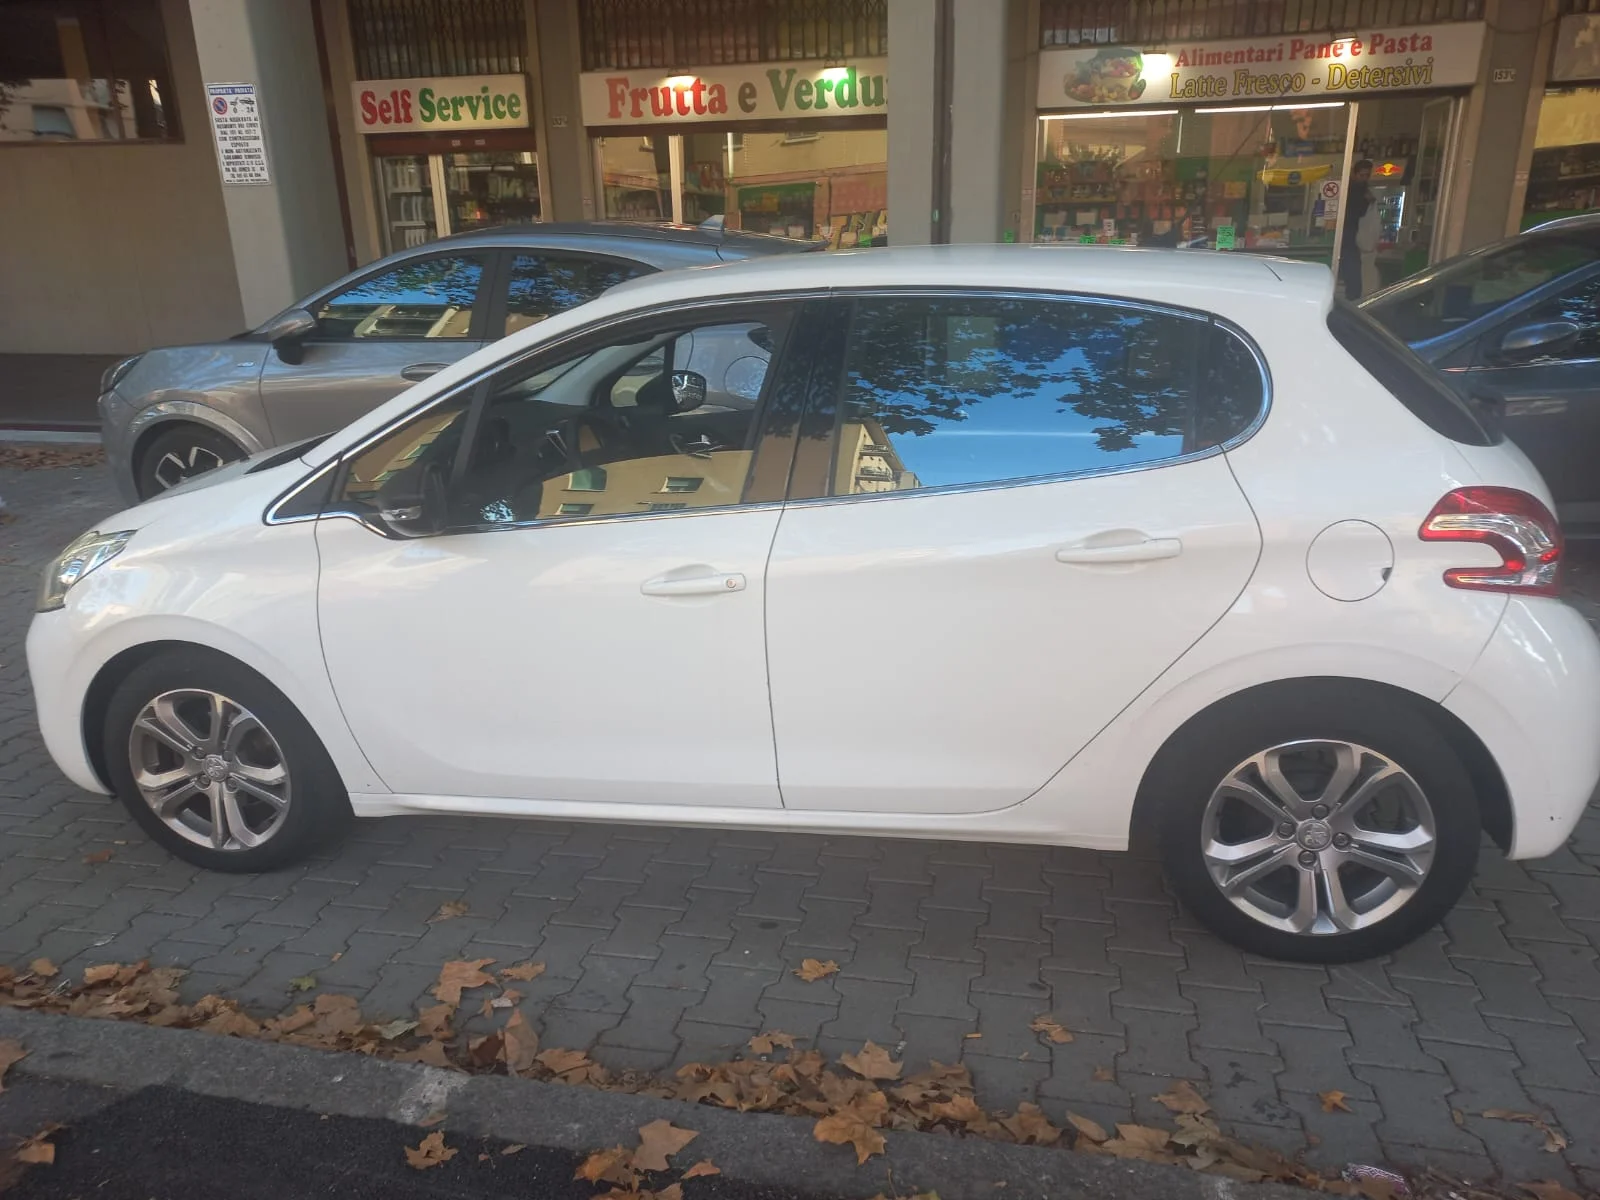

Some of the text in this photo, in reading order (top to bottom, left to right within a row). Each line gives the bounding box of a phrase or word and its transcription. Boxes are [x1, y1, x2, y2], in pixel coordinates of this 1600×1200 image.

[1175, 33, 1433, 68] Alimentari Pane e Pasta
[605, 65, 887, 119] Frutta e Verdu
[1169, 72, 1228, 99] Latte
[1232, 68, 1306, 97] Fresco
[1325, 56, 1435, 91] Detersivi
[360, 85, 521, 126] Self Service
